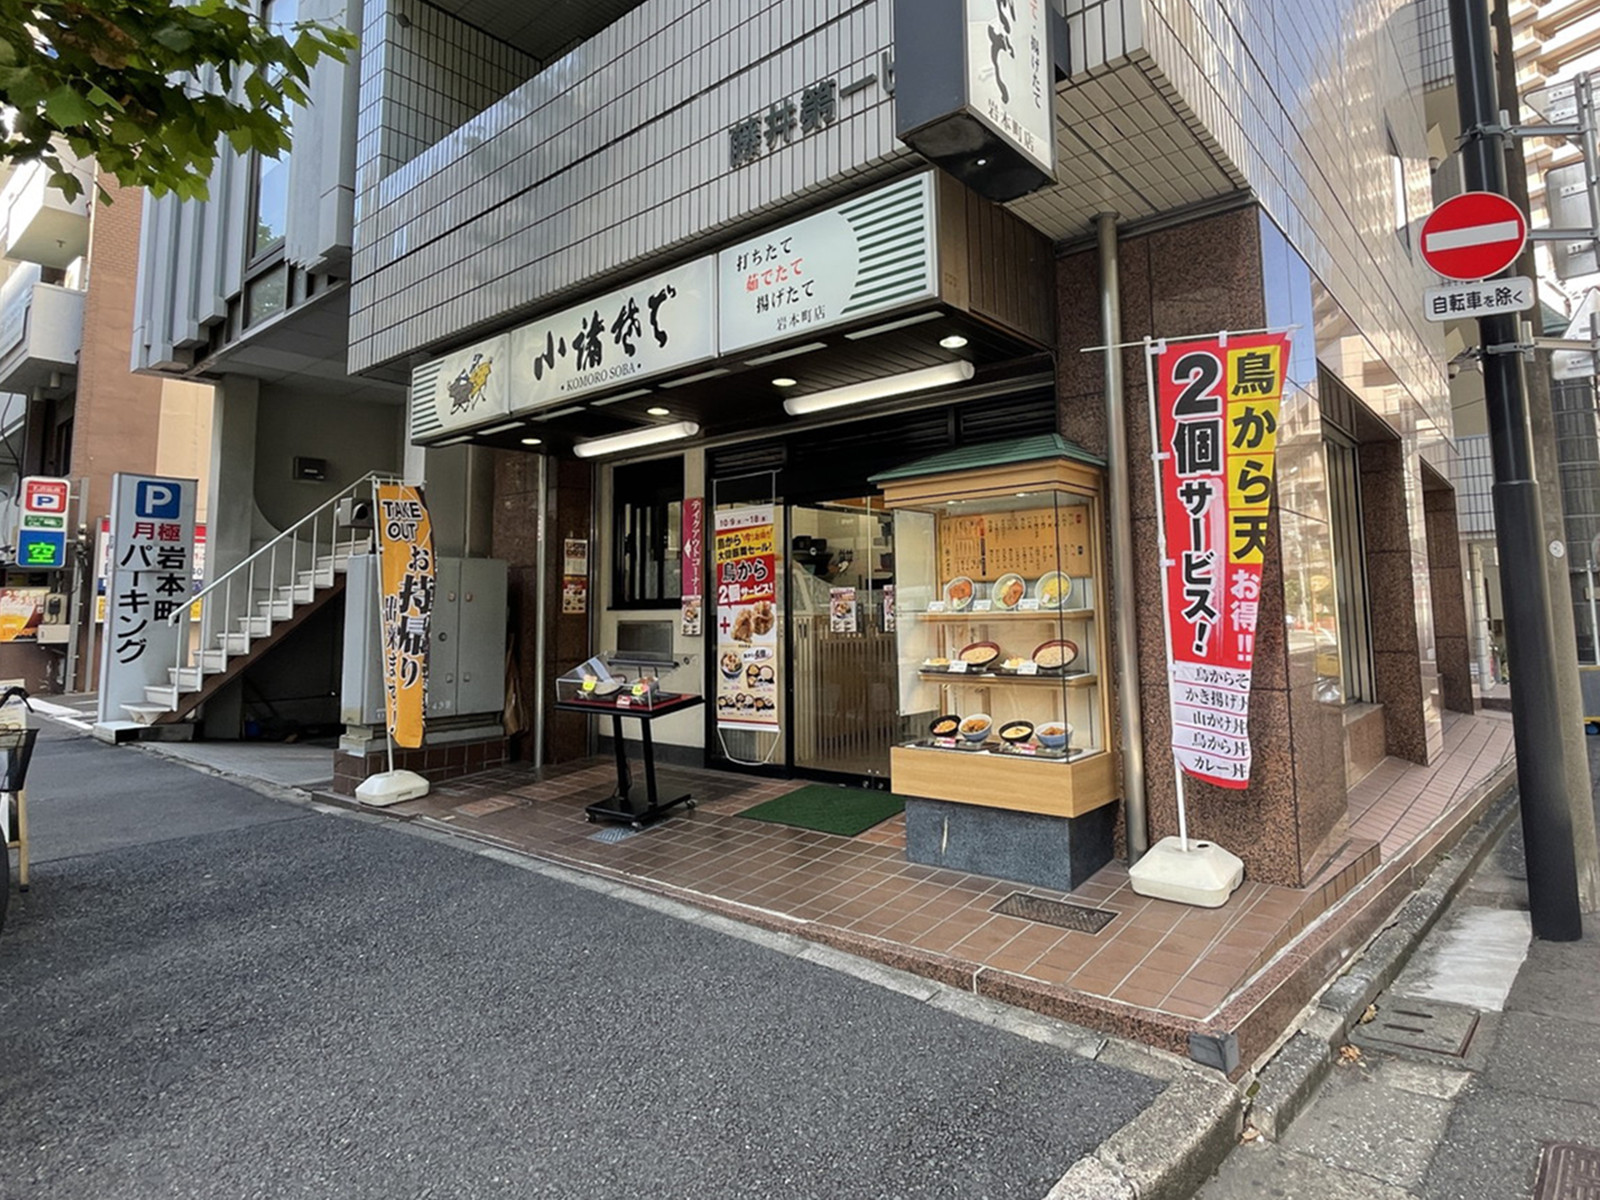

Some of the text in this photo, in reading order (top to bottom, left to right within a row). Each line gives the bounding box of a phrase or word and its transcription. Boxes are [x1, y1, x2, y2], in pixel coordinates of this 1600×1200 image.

[988, 98, 1034, 152] 岩本町店
[736, 237, 793, 272] 打ちたて
[746, 258, 804, 293] 茹でたて
[756, 280, 815, 314] 揚げたて
[1432, 286, 1524, 315] 自転車を除く
[776, 304, 826, 331] 岩本町店
[566, 363, 636, 392] KOMORO SOBA
[1231, 352, 1277, 560] 鳥から天
[382, 501, 422, 519] TAKE
[132, 522, 181, 542] 月極
[387, 522, 416, 541] OUT
[691, 500, 701, 596] テイクアウトコーナー
[27, 541, 56, 563] 空
[153, 546, 186, 624] 岩本町
[722, 558, 768, 583] 鳥から
[117, 544, 153, 664] パーキング
[399, 545, 433, 689] お持帰り
